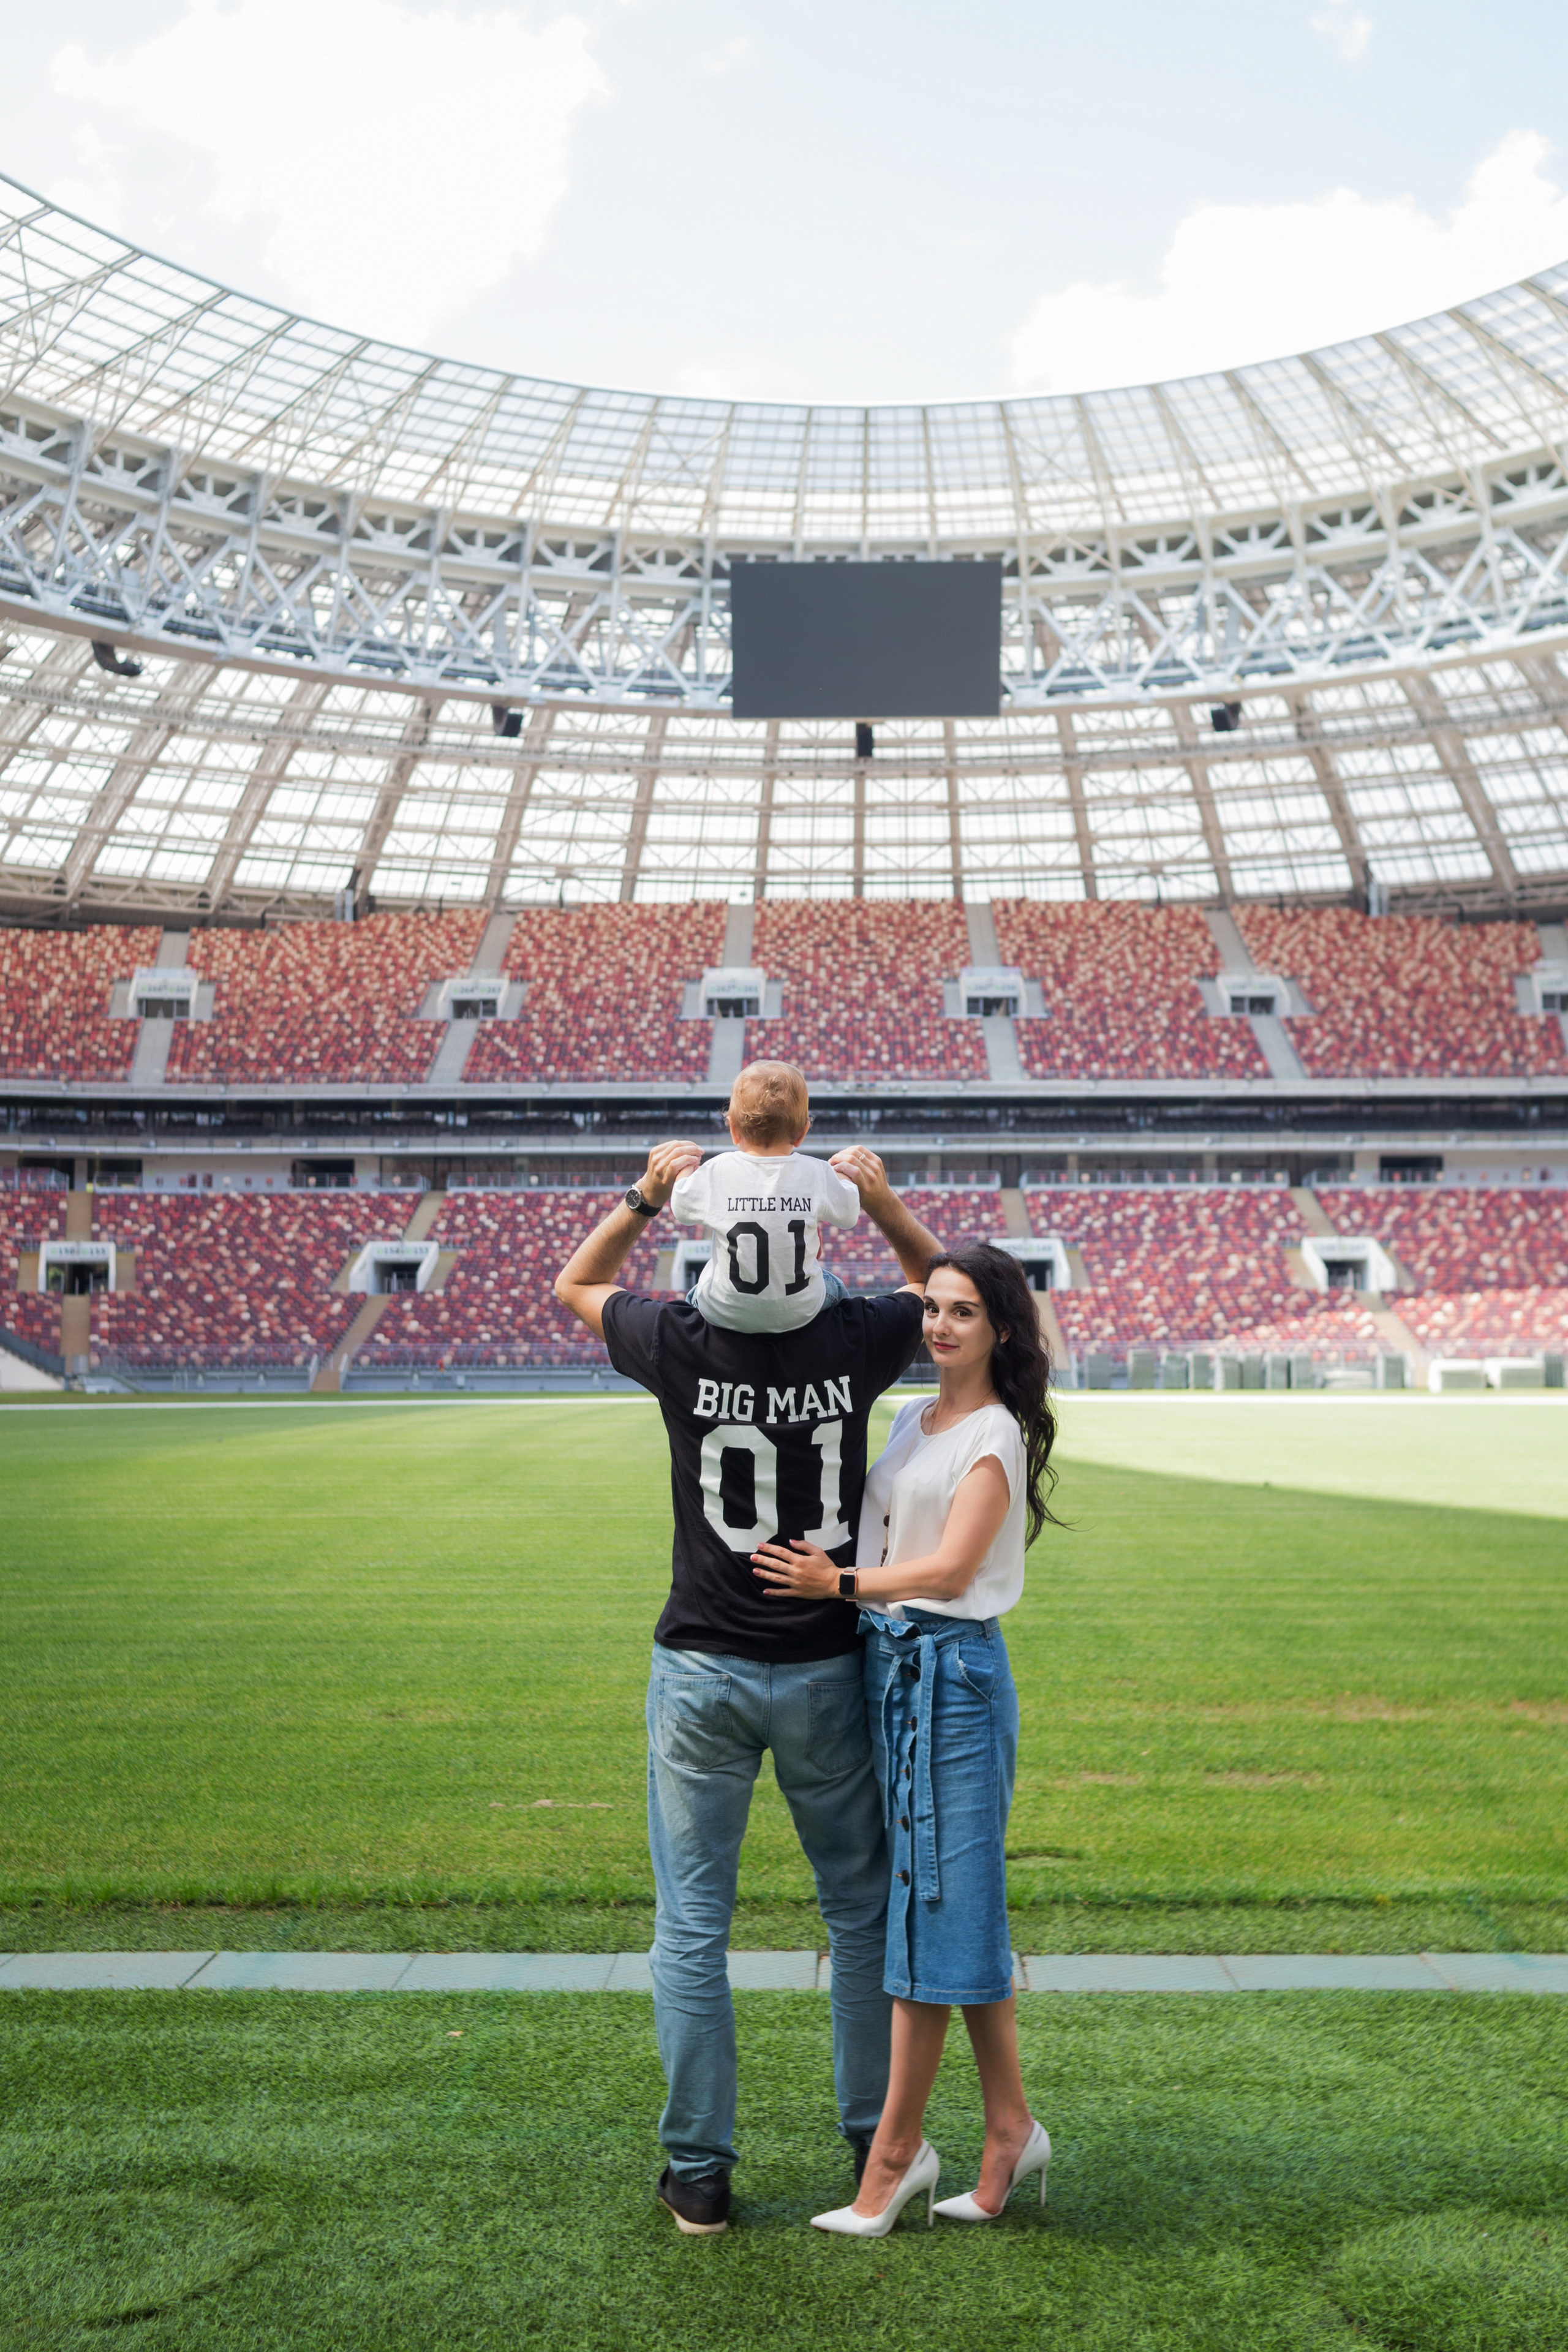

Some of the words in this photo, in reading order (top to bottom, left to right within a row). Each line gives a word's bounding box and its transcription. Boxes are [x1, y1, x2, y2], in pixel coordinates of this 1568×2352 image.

[728, 1197, 776, 1212] LITTLE
[781, 1197, 811, 1212] MAN
[726, 1219, 810, 1296] 01
[693, 1378, 755, 1422] BIG
[766, 1376, 853, 1423] MAN
[699, 1419, 852, 1553] 01
